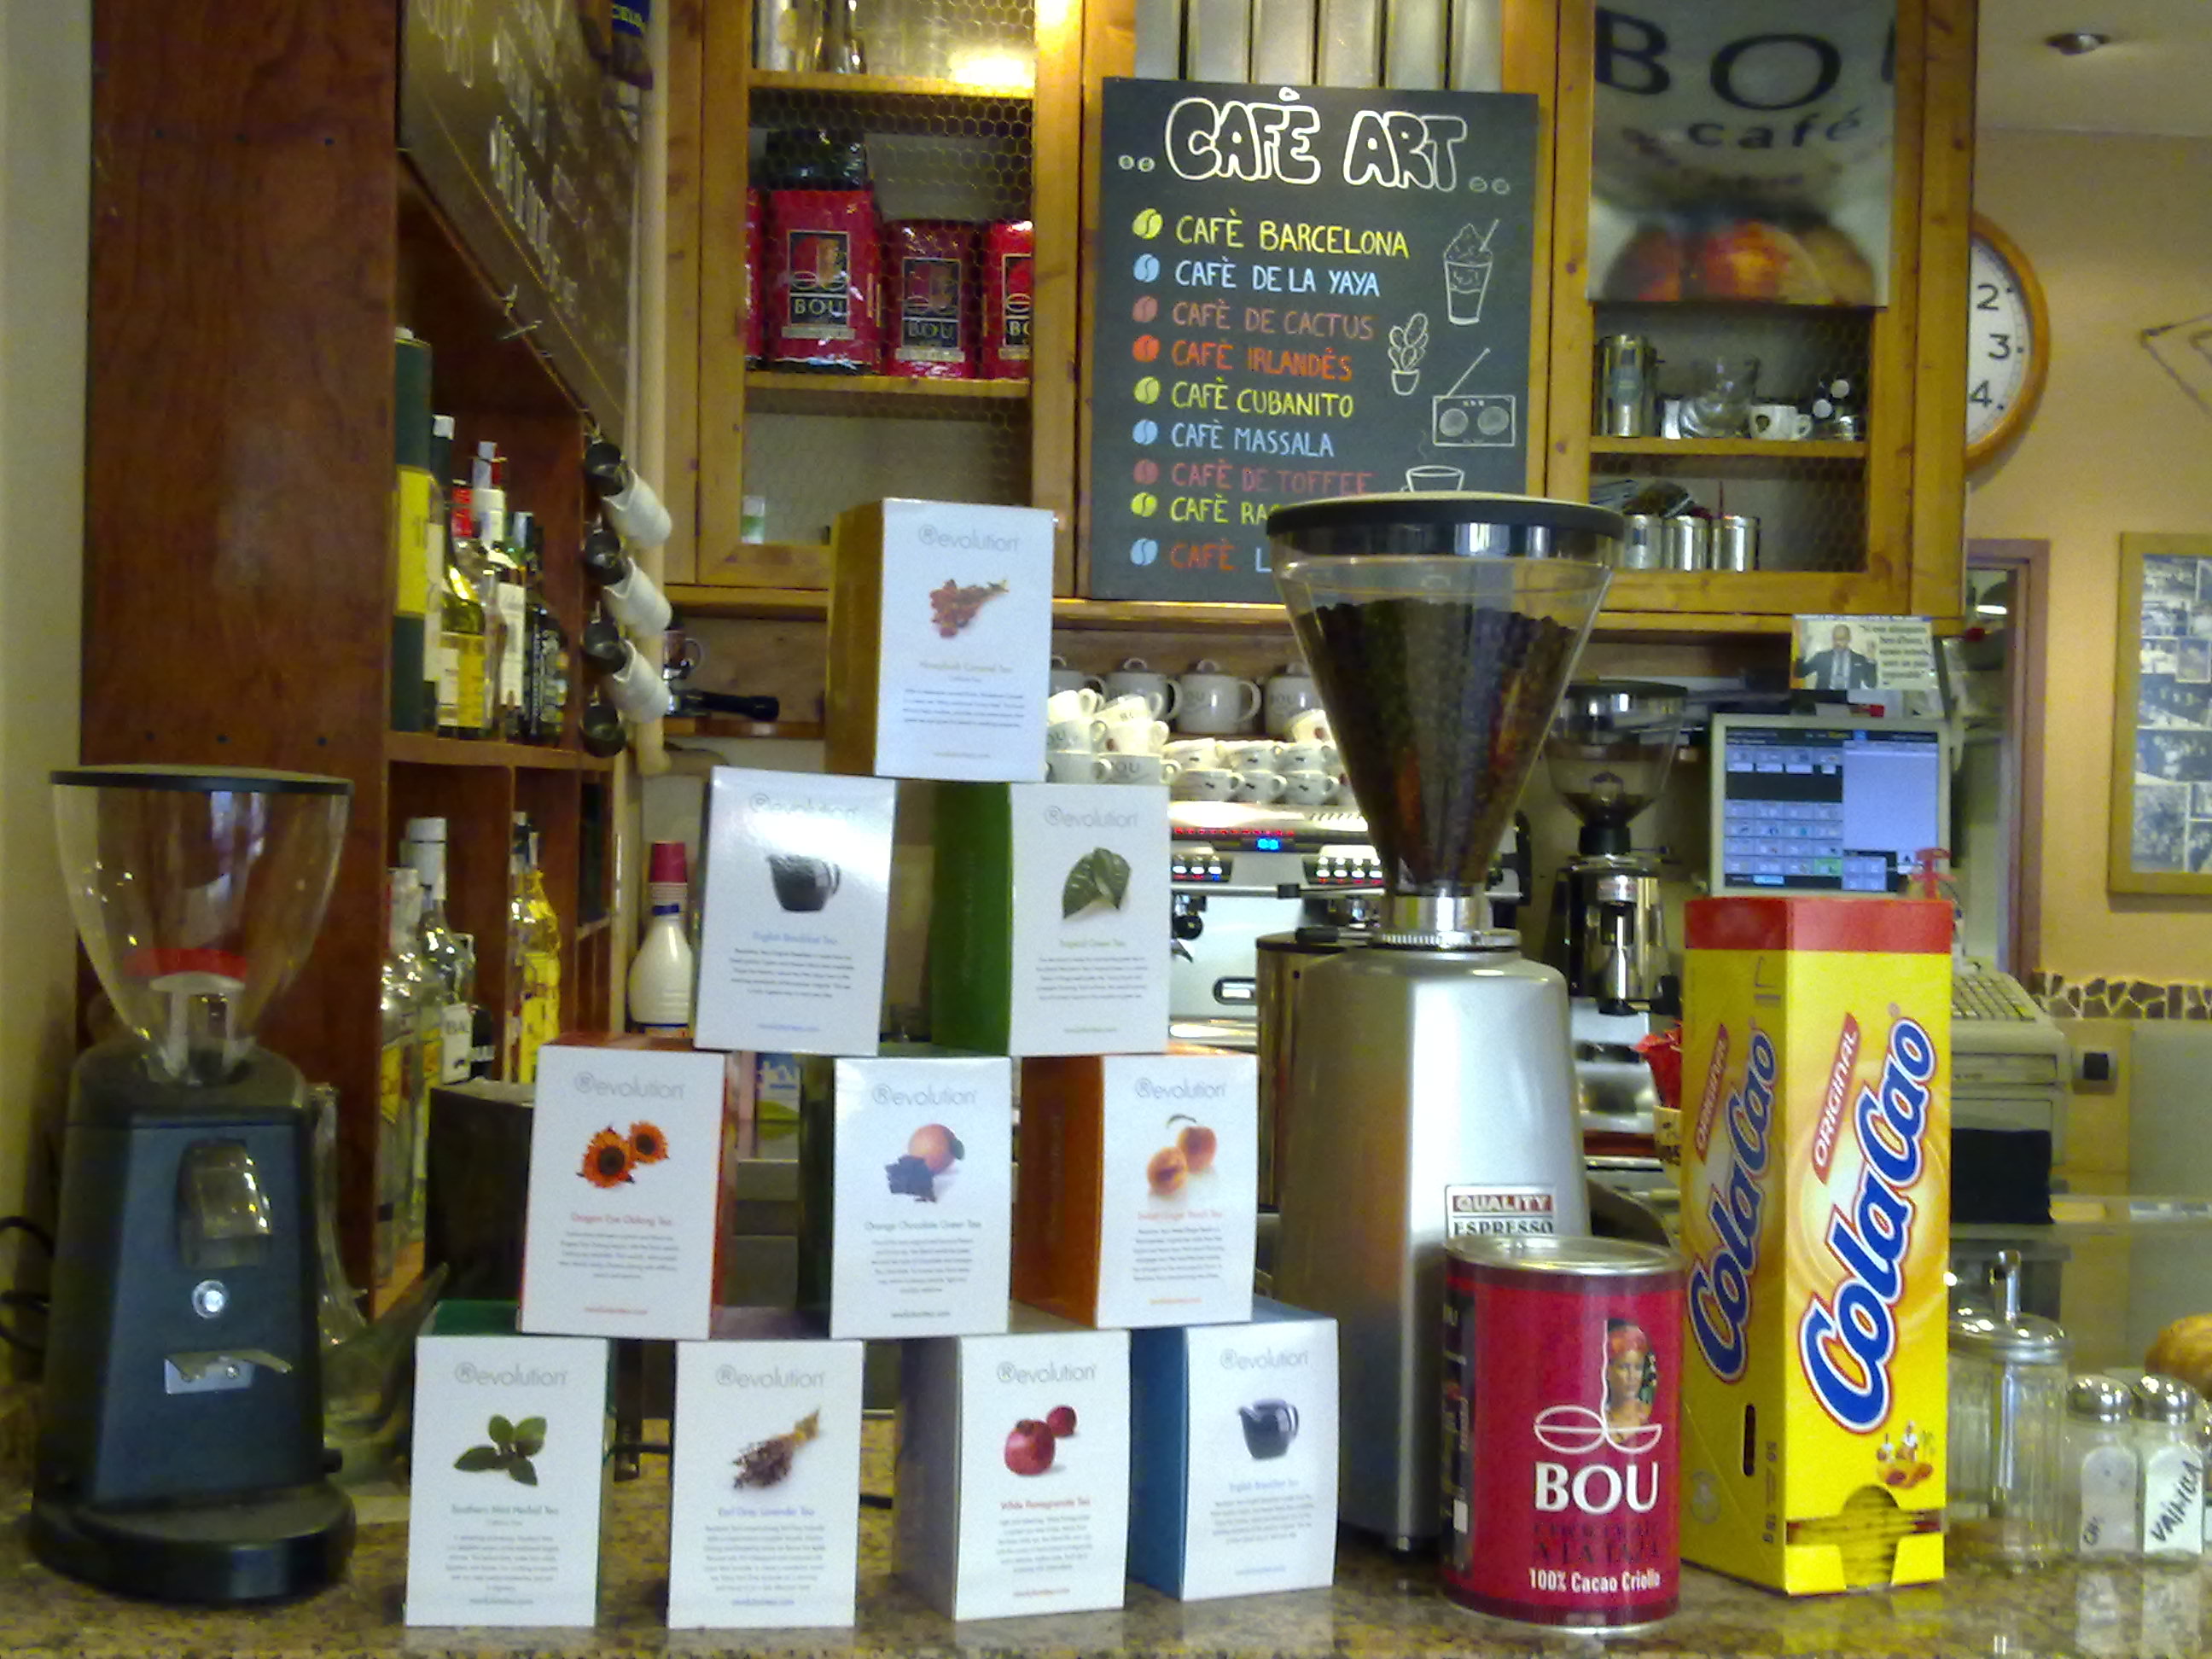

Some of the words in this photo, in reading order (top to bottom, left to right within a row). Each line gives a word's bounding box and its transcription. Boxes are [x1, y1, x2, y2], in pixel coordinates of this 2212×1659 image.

[1594, 5, 1895, 110] BO
[1343, 111, 1467, 191] ART
[1260, 219, 1410, 259] BARCELONA
[1253, 266, 1282, 292] DE
[1289, 267, 1316, 294] LA
[1328, 270, 1381, 298] YAYA
[1976, 283, 2000, 311] 2
[794, 300, 843, 316] BOU
[1244, 309, 1276, 334] DE
[1284, 311, 1376, 341] CACTUS
[1988, 333, 2011, 360] 3
[1237, 387, 1354, 418] CUBANITO
[1969, 380, 1993, 408] 4
[1234, 428, 1335, 458] MASSALA
[1241, 466, 1271, 492] DE
[1277, 470, 1377, 496] TOFFEE
[1813, 1030, 1858, 1168] ORIGINAL
[1455, 1194, 1549, 1212] QUALITY
[1534, 1461, 1660, 1515] BOU
[1528, 1566, 1568, 1593] 100%
[1570, 1571, 1618, 1594] Cacao
